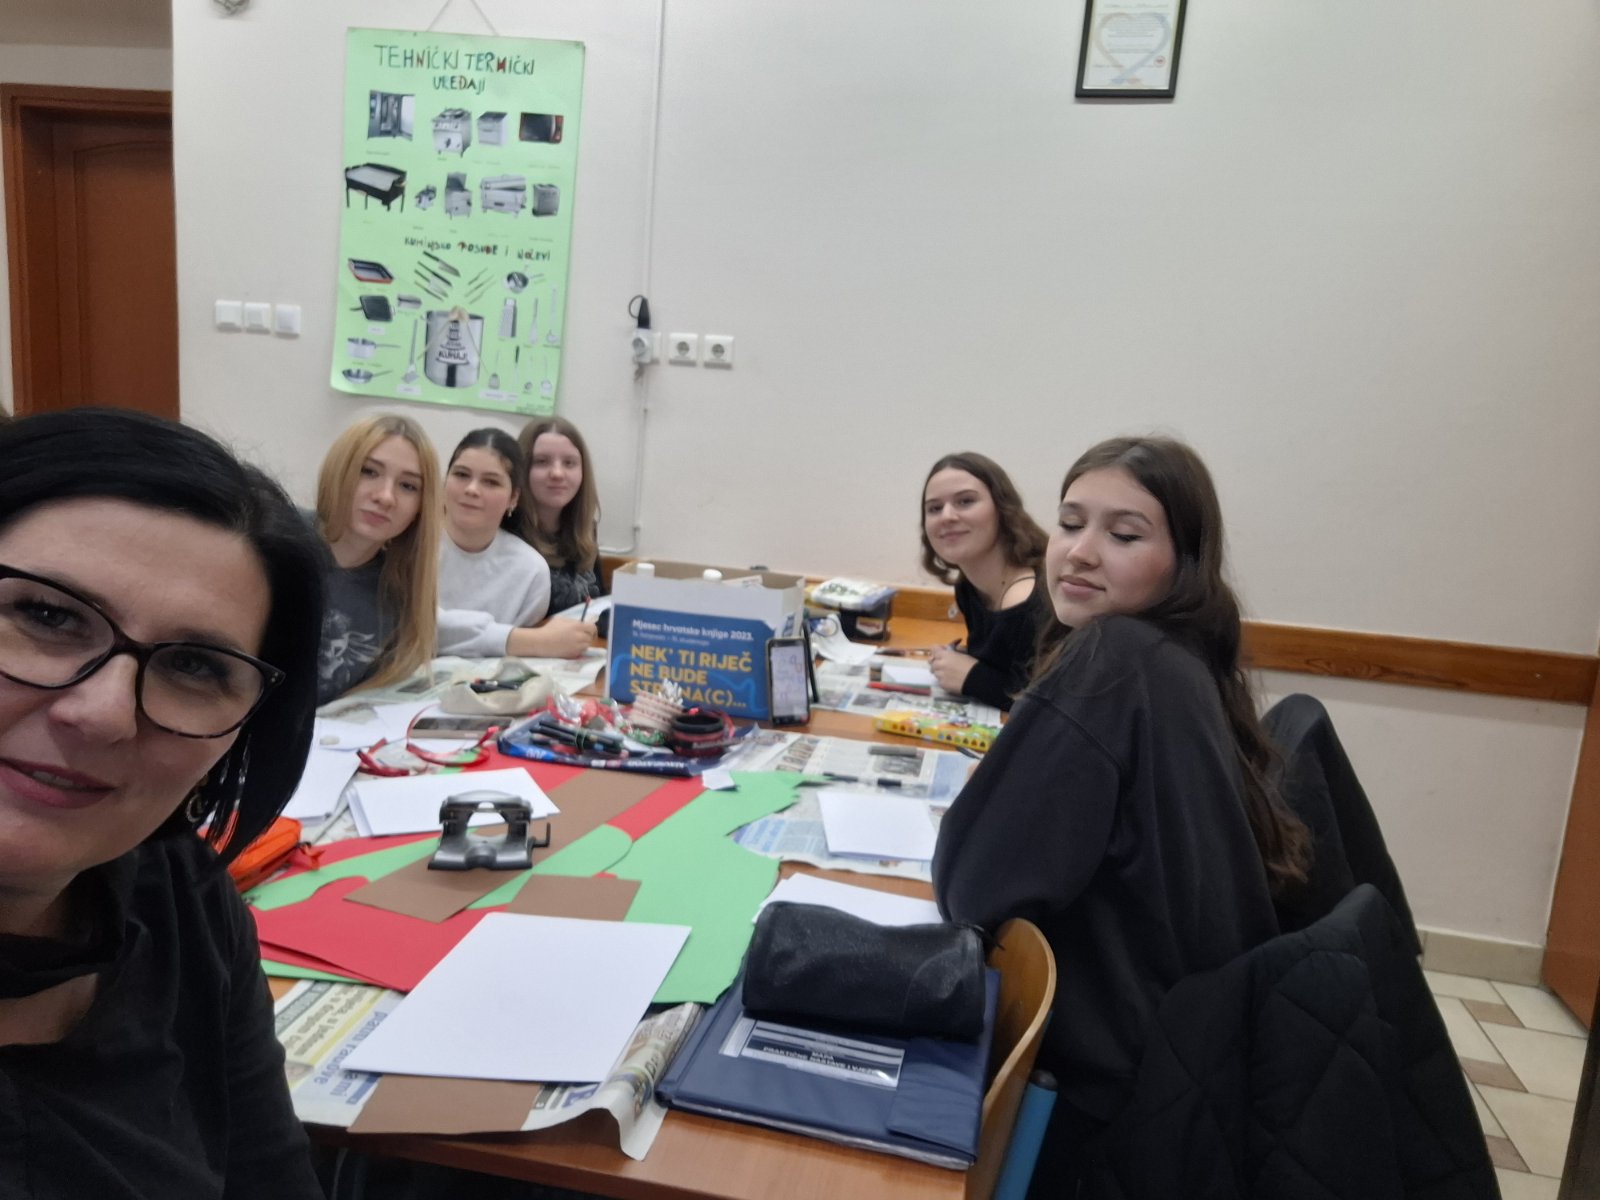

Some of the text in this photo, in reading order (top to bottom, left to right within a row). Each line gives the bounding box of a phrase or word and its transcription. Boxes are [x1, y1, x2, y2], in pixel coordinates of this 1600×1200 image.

[632, 618, 661, 632] Mjesec
[663, 623, 701, 636] hrvatske
[702, 627, 729, 640] knjige
[630, 644, 753, 673] NEK' TI RIJEČ
[630, 661, 708, 686] NE BUDE
[629, 679, 747, 709] STRNA(C)...
